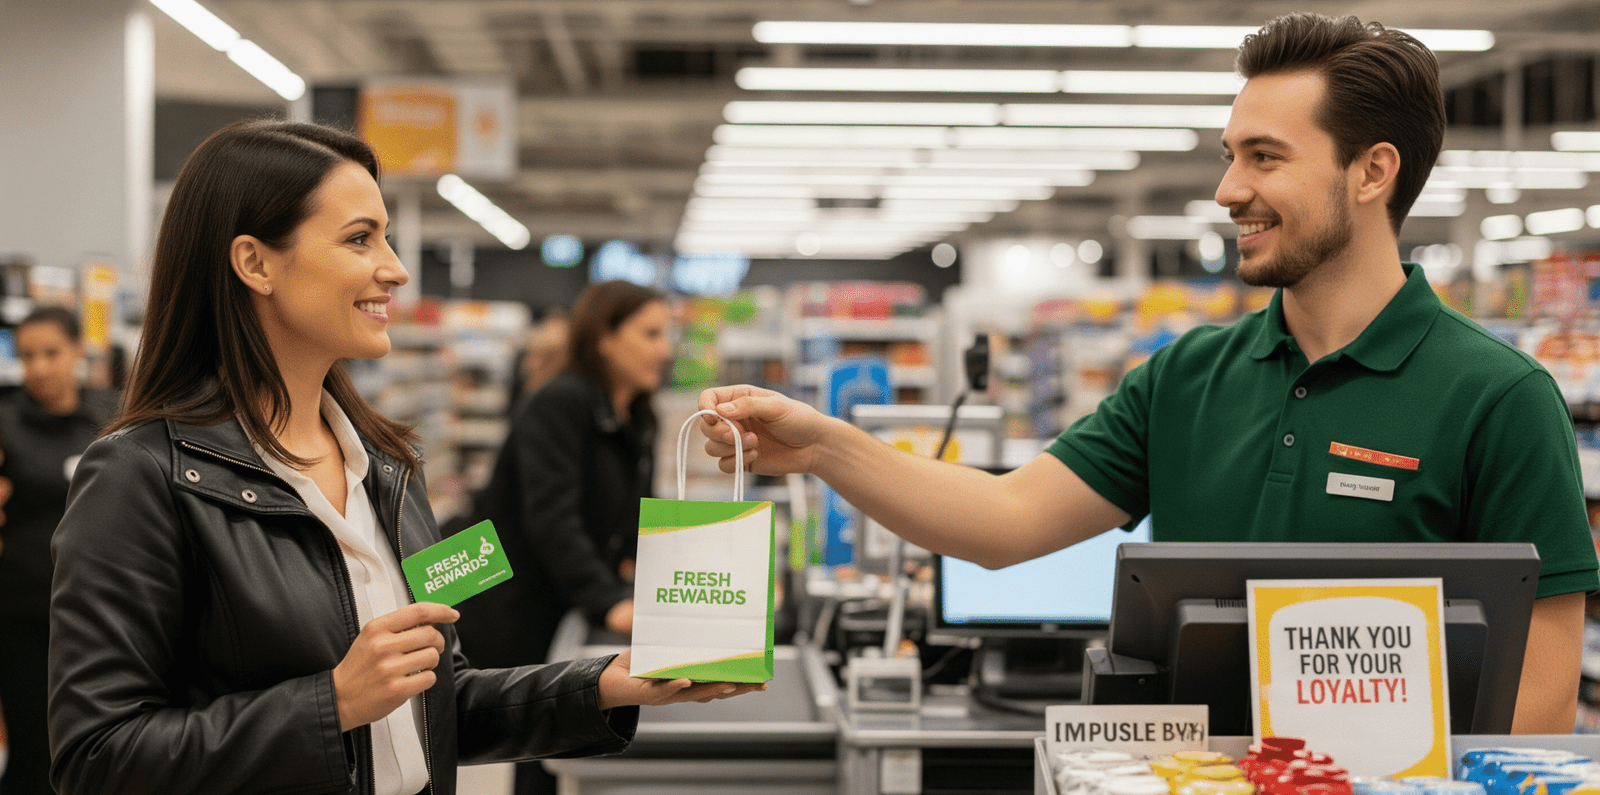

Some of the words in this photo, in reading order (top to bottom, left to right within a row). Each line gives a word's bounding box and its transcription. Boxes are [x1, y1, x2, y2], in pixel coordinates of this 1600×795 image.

[424, 554, 488, 594] REWARDS
[426, 550, 469, 579] FRESH
[674, 571, 731, 587] FRESH
[656, 588, 746, 605] REWARDS
[1284, 626, 1361, 650] THANK
[1367, 625, 1411, 648] YOU
[1300, 653, 1339, 674] FOR
[1346, 653, 1402, 674] YOUR
[1297, 678, 1407, 704] LOYALTY!
[1055, 722, 1155, 742] IMPUSLE
